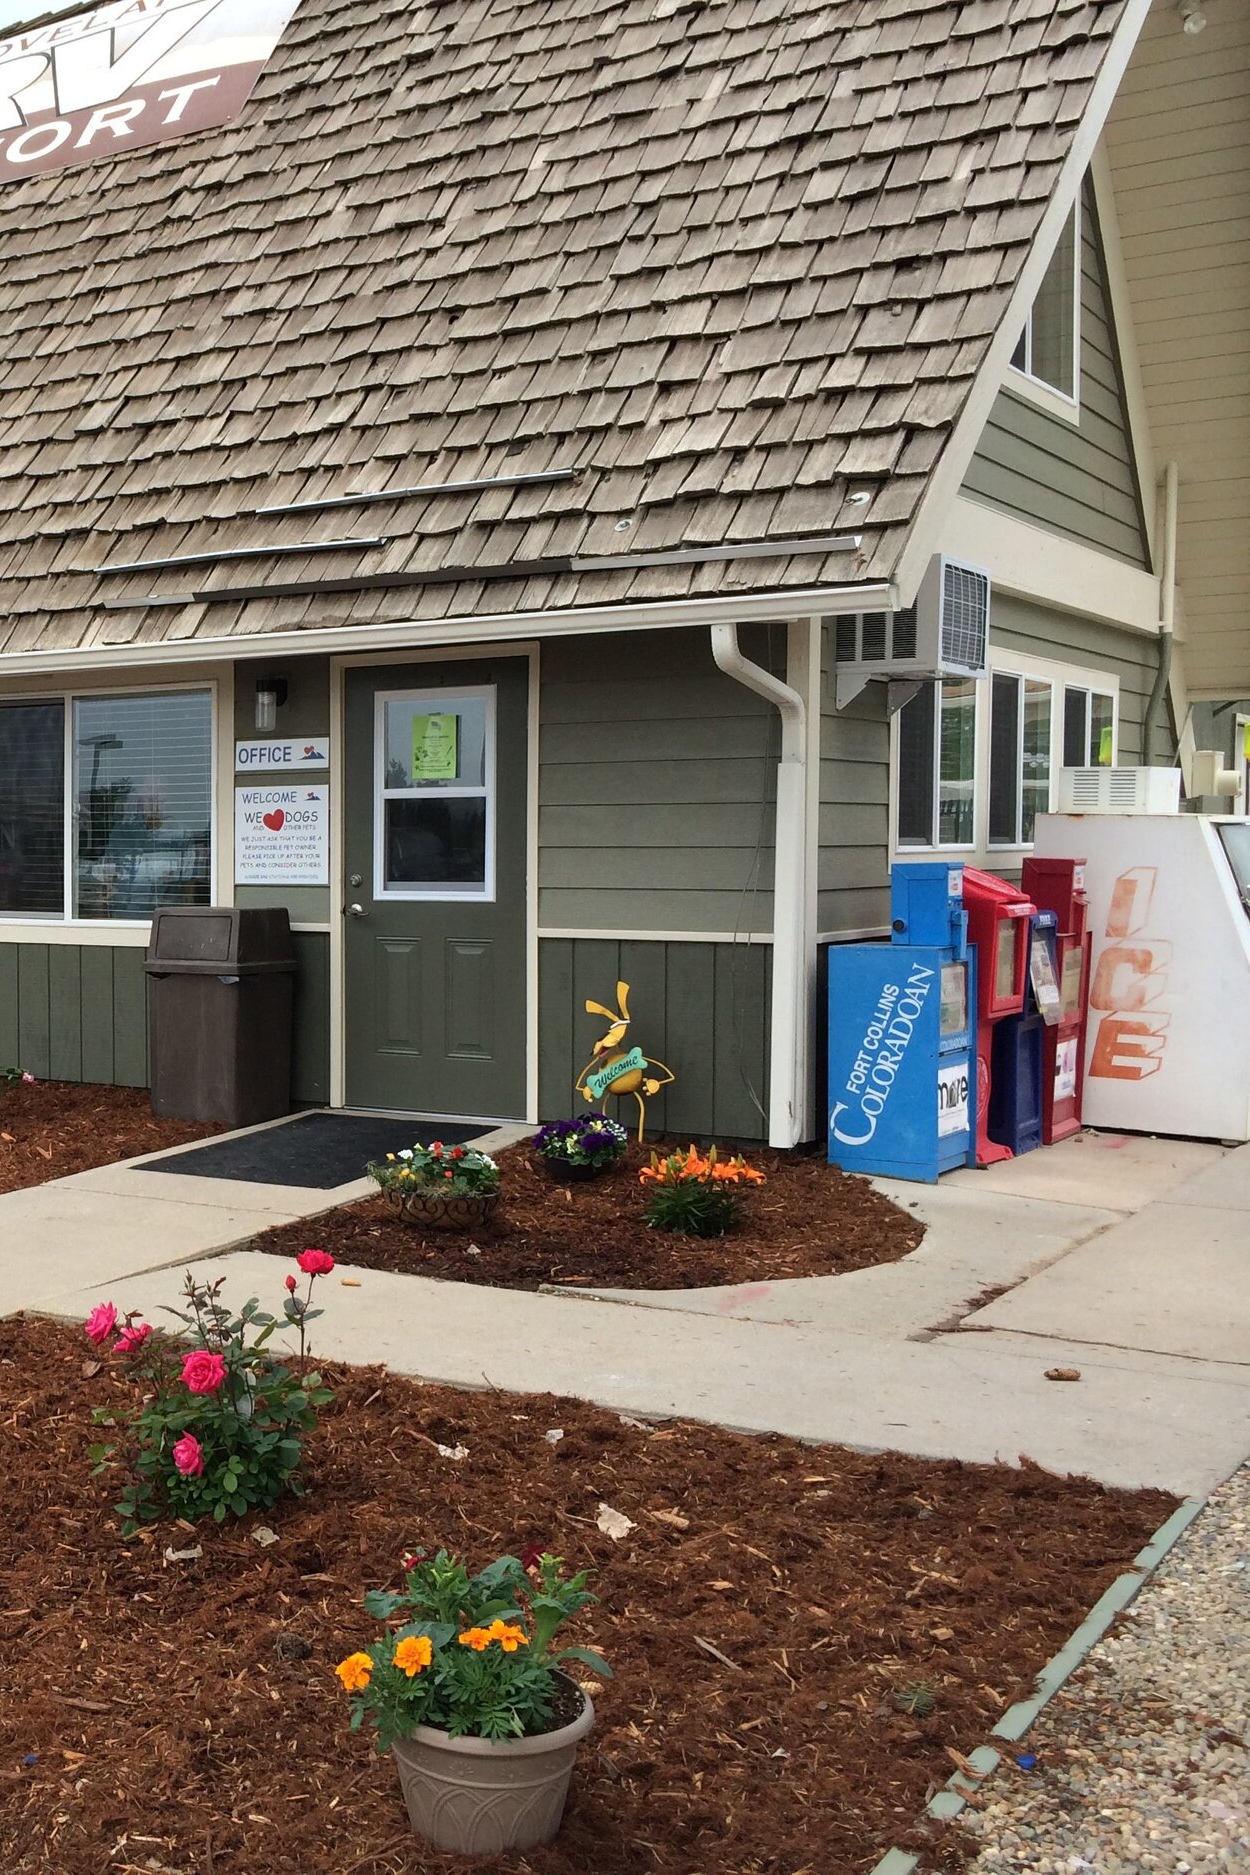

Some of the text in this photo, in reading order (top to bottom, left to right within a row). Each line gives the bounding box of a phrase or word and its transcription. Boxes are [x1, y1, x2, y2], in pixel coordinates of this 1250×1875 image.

[238, 746, 292, 764] OFFICE
[242, 791, 297, 804] WELCOME
[244, 811, 318, 824] WE DOGS
[1089, 866, 1173, 1081] ICE
[829, 962, 935, 1146] COLORADOAN
[846, 983, 900, 1094] FORT COLLINS
[595, 1055, 638, 1088] Welcome
